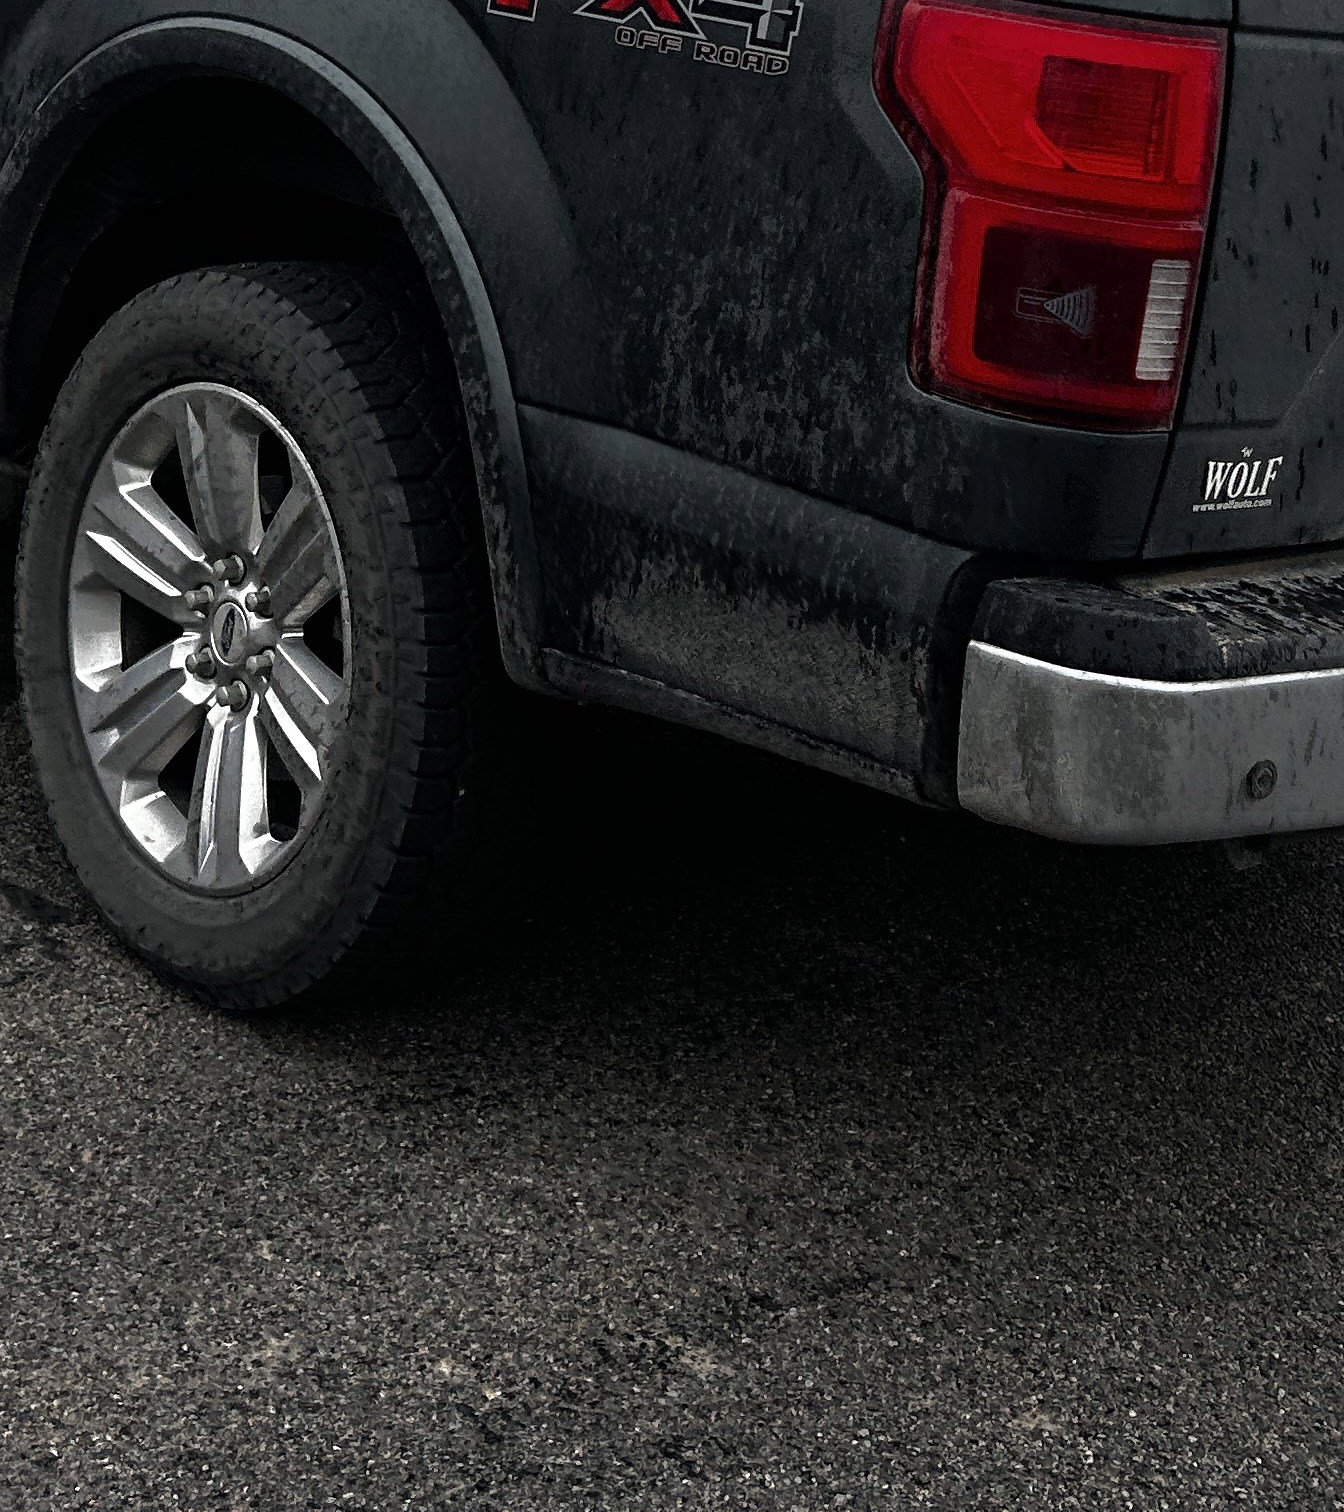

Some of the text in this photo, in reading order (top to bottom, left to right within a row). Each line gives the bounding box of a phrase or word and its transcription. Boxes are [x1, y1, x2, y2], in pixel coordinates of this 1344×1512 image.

[615, 25, 789, 75] OFF ROAD
[1204, 455, 1284, 501] WOLF
